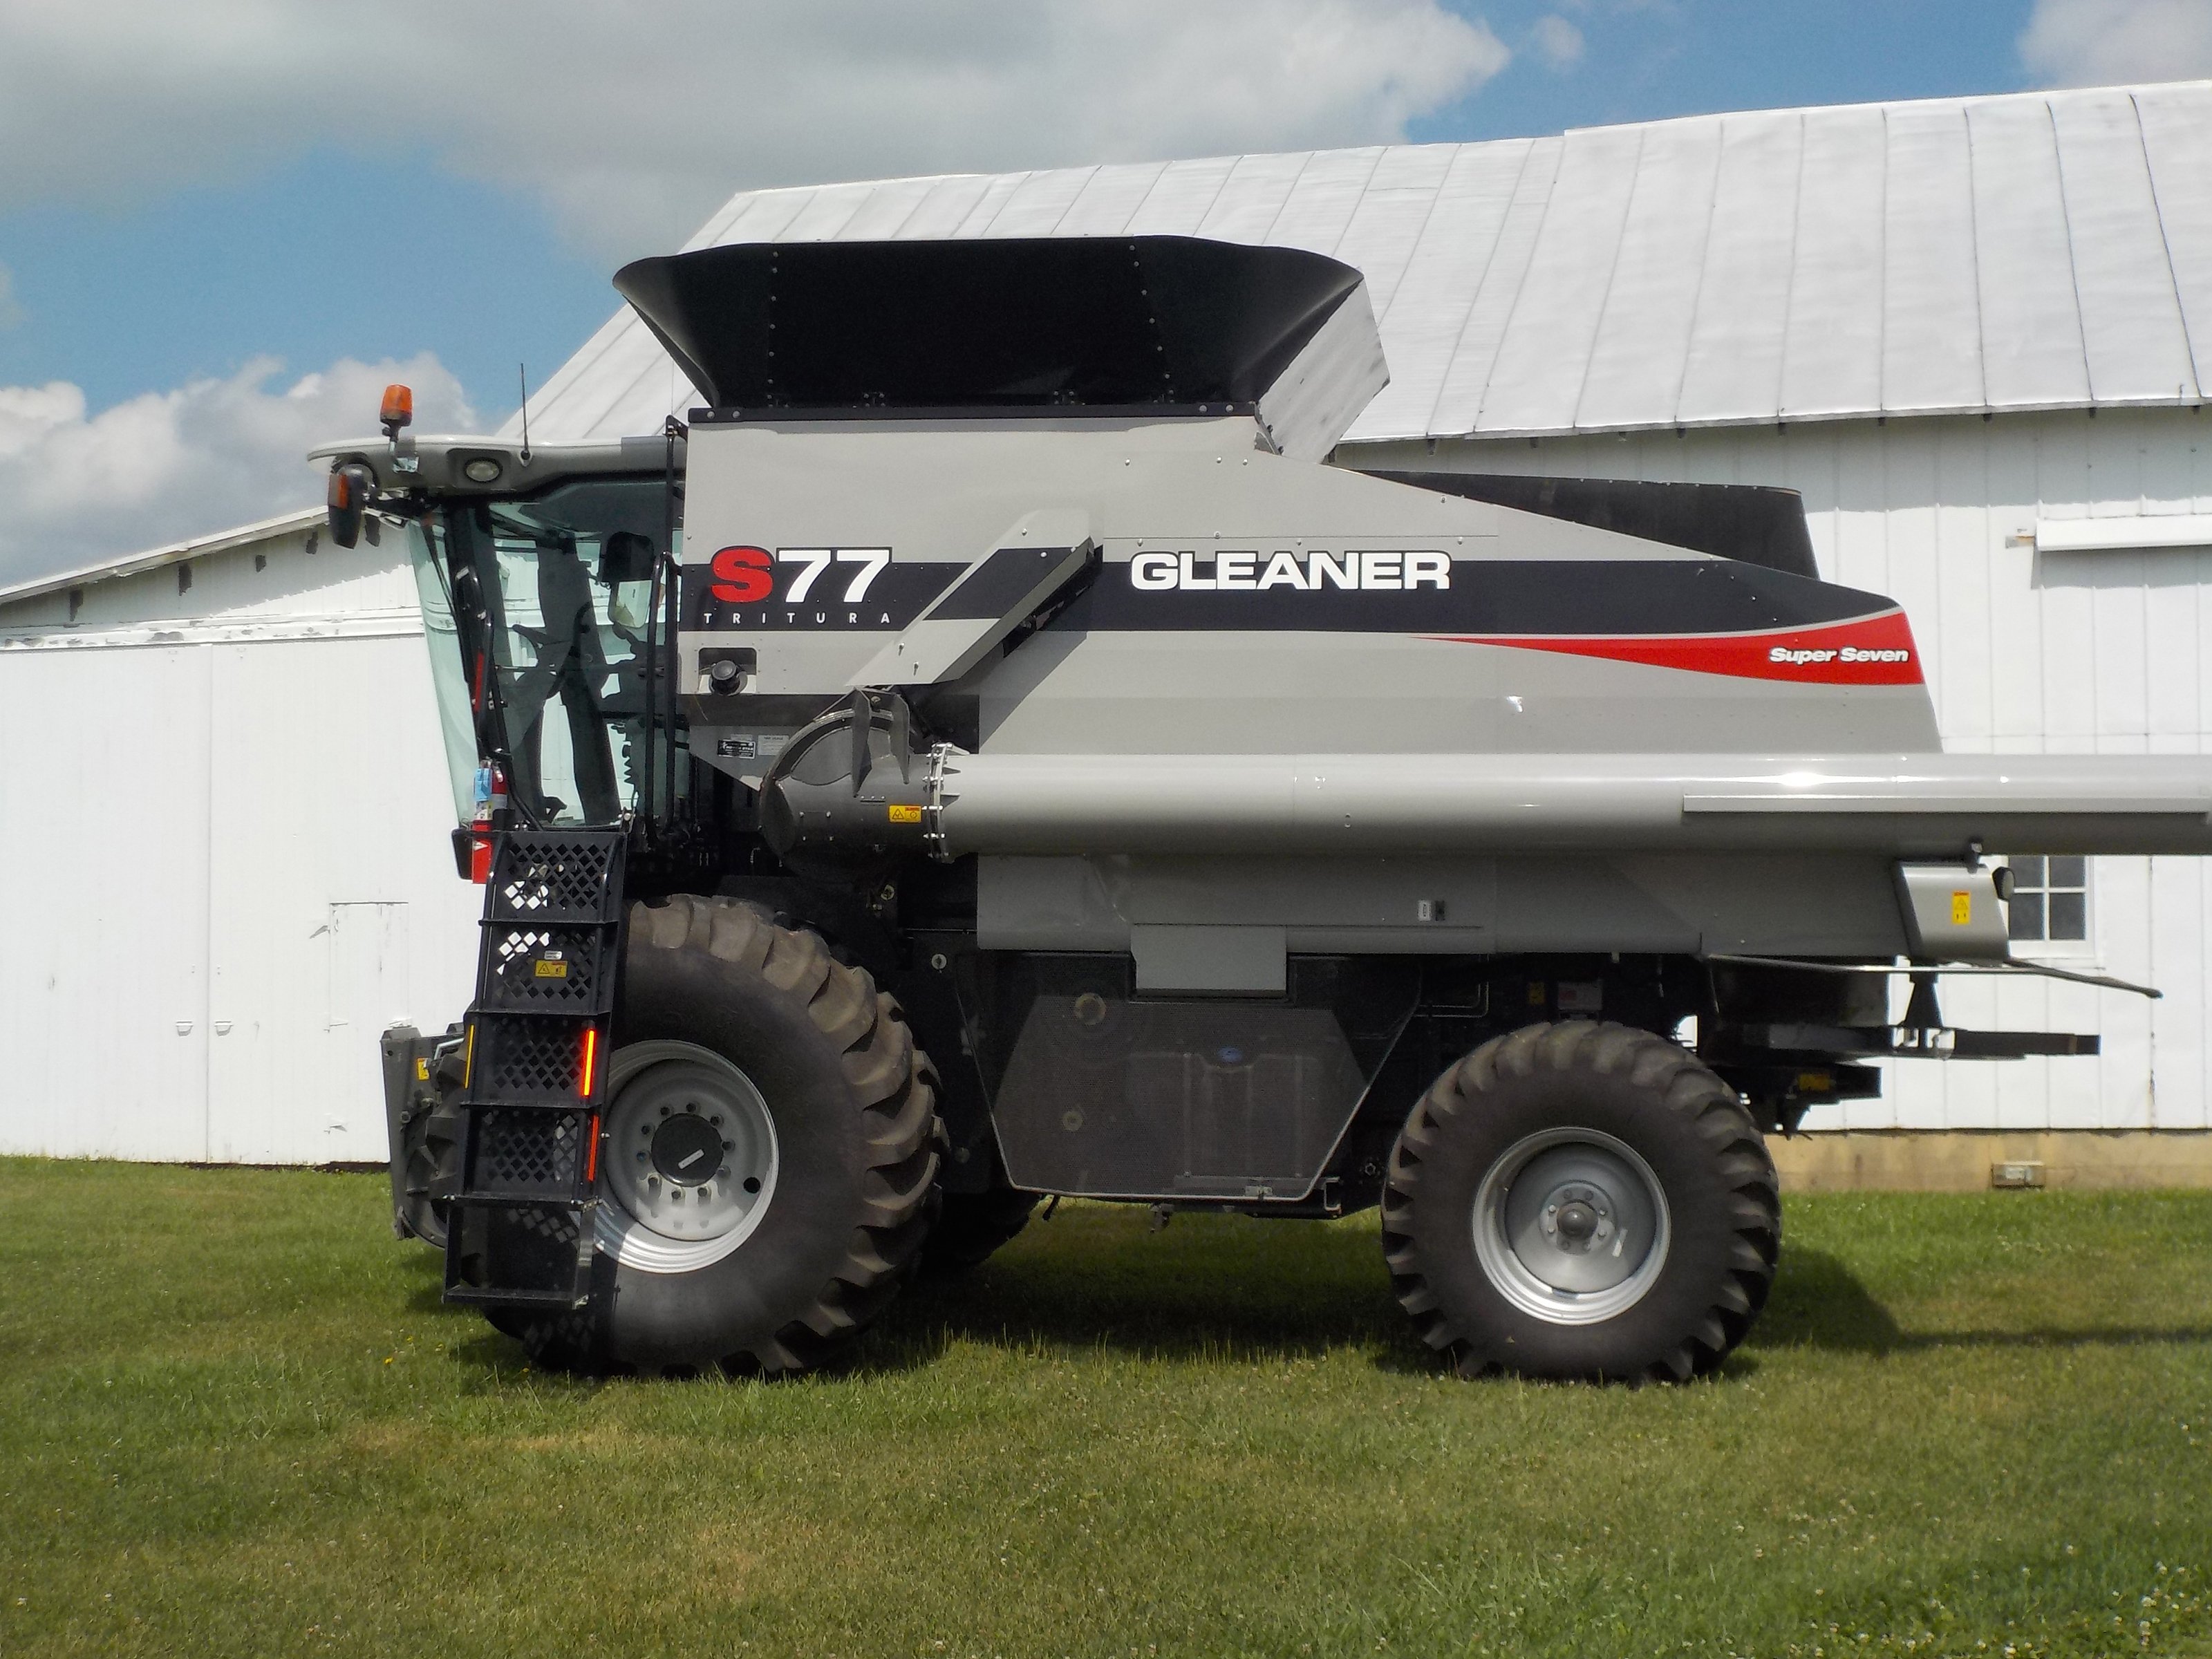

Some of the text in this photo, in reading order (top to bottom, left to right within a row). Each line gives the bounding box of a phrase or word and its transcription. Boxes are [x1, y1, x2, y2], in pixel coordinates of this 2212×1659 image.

[711, 547, 890, 603] S77
[1131, 551, 1451, 590] GLEANER
[703, 612, 890, 624] TRITURA
[1770, 646, 1910, 664] Super Seven
